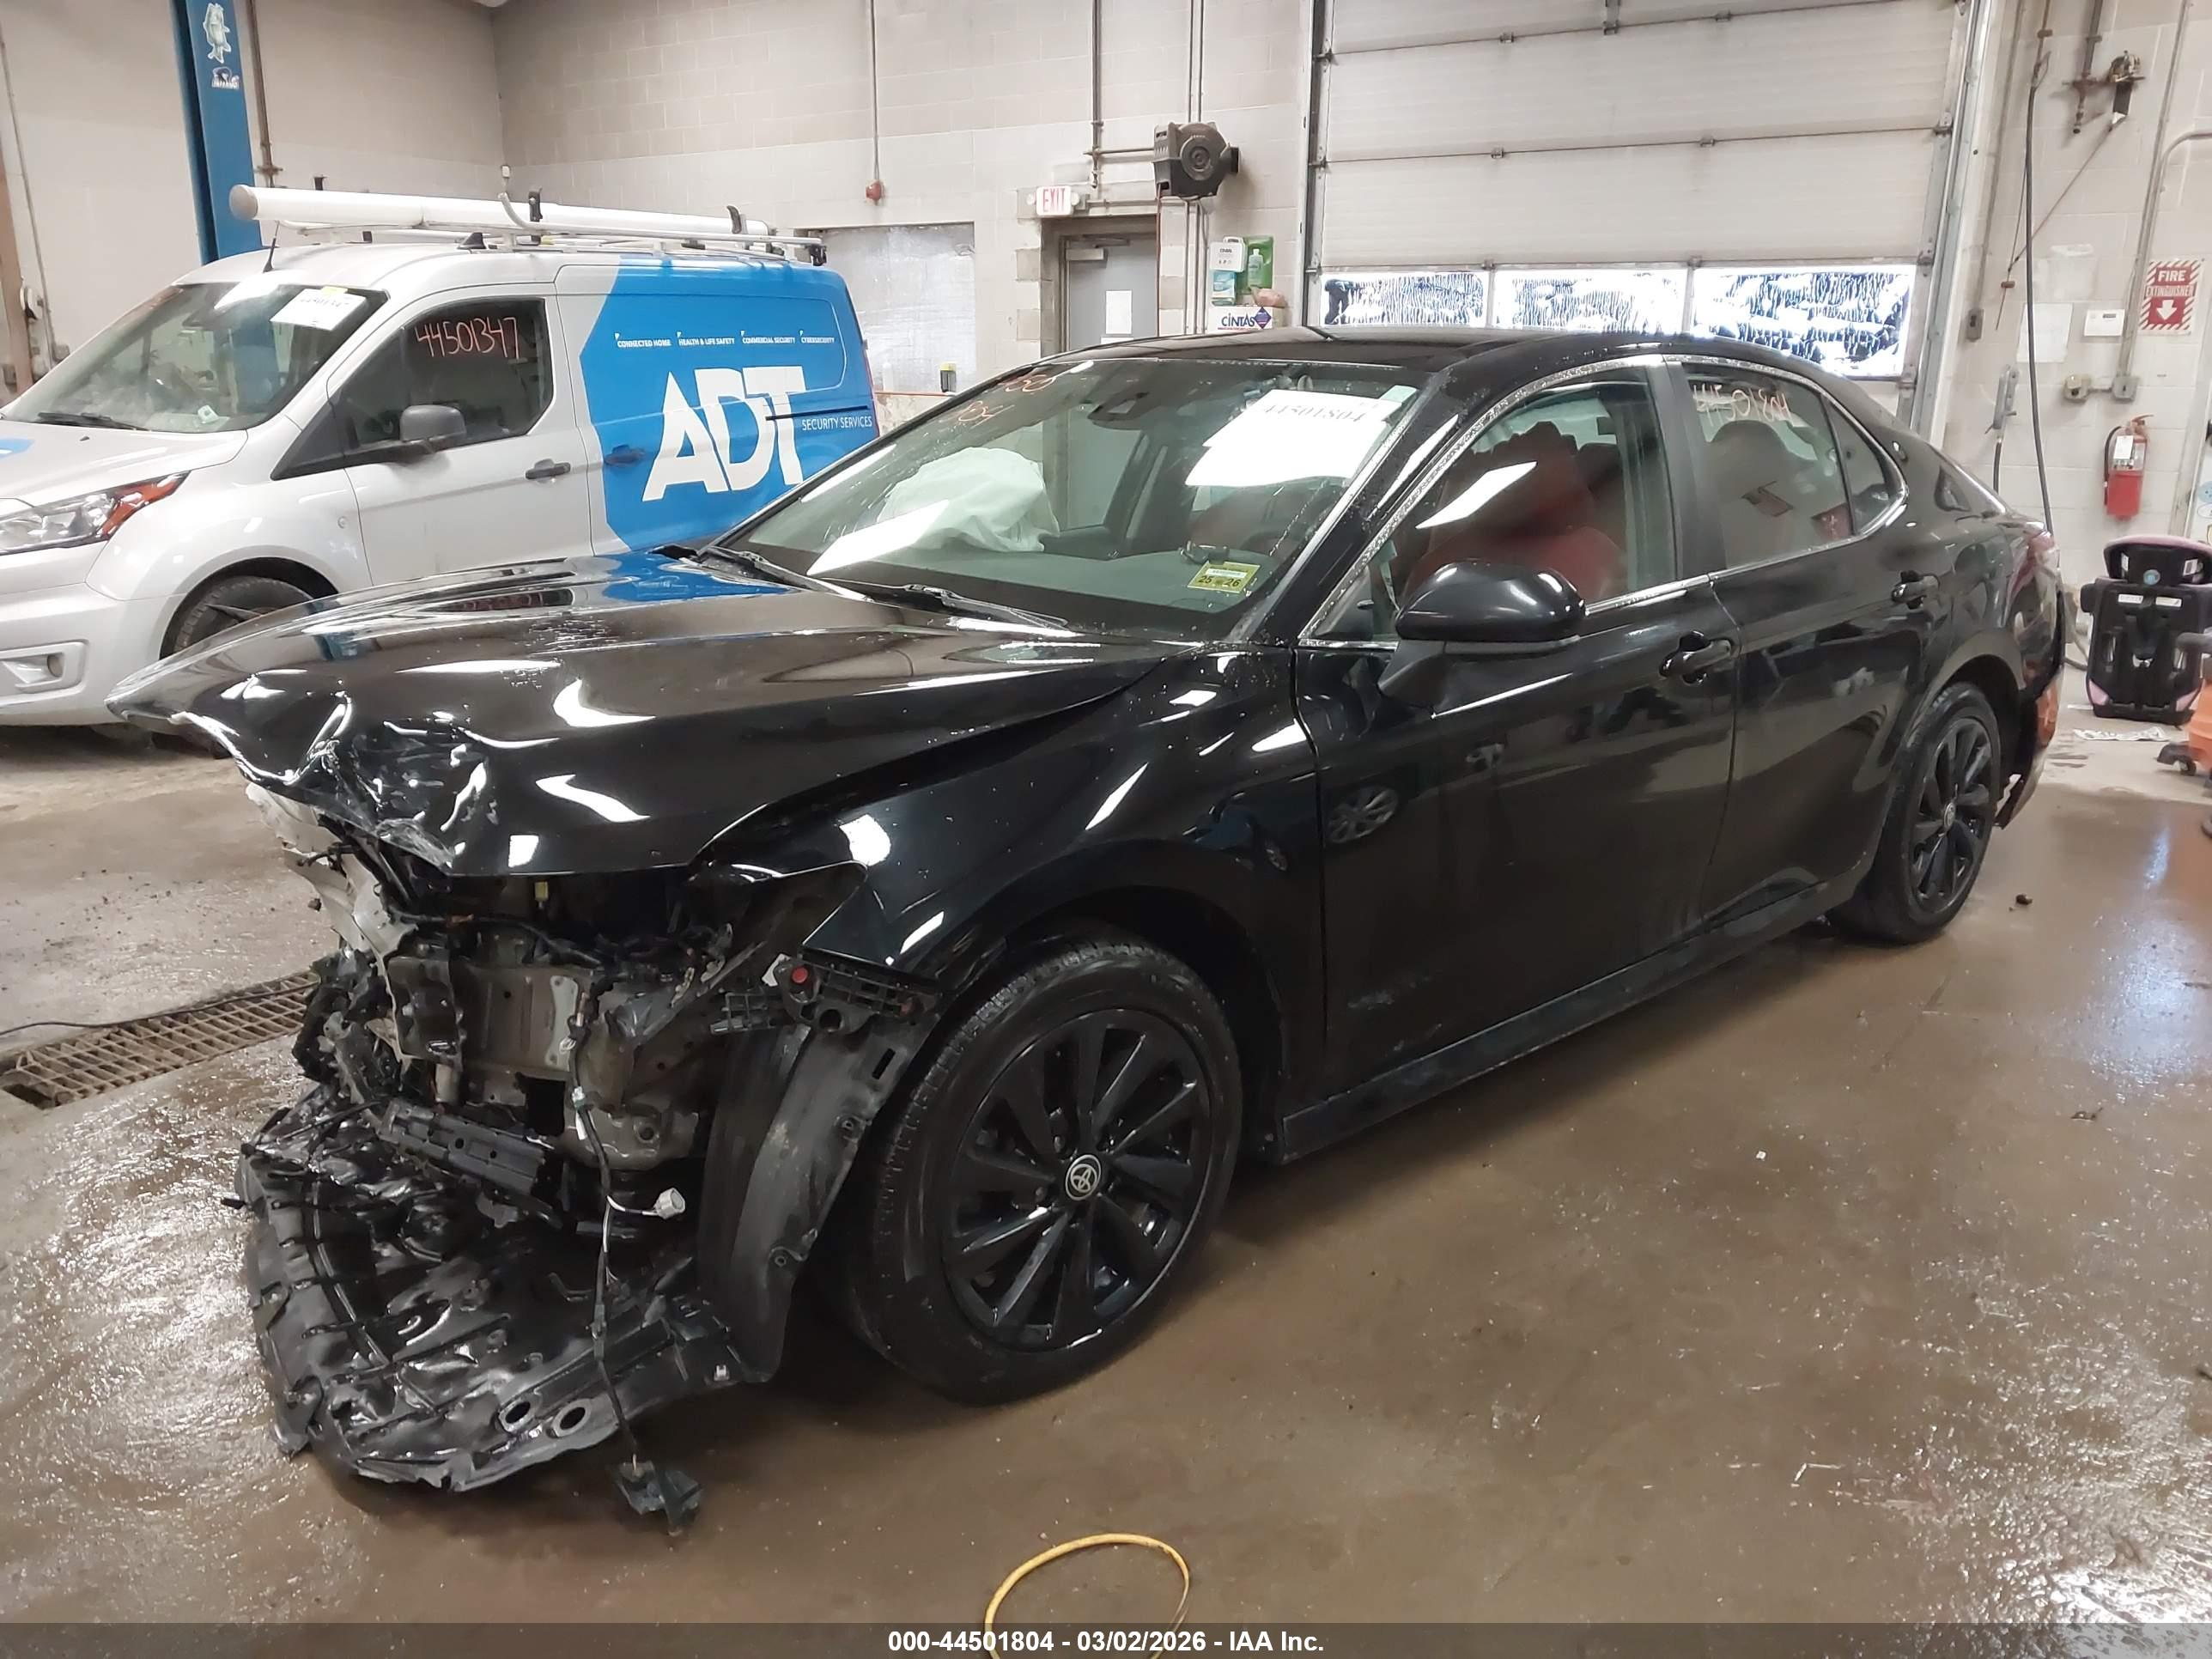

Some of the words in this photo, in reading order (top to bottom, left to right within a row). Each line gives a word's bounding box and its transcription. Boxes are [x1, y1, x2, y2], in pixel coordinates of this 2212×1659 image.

[1042, 188, 1066, 212] EXIT
[2158, 270, 2187, 282] FIRE
[2145, 284, 2195, 297] EXTINGUISHER
[414, 316, 520, 360] 44501347
[802, 417, 839, 431] SECURITY
[840, 416, 872, 428] SERVICES
[642, 366, 806, 501] ADT
[1198, 575, 1212, 584] 25
[1224, 578, 1242, 587] 26
